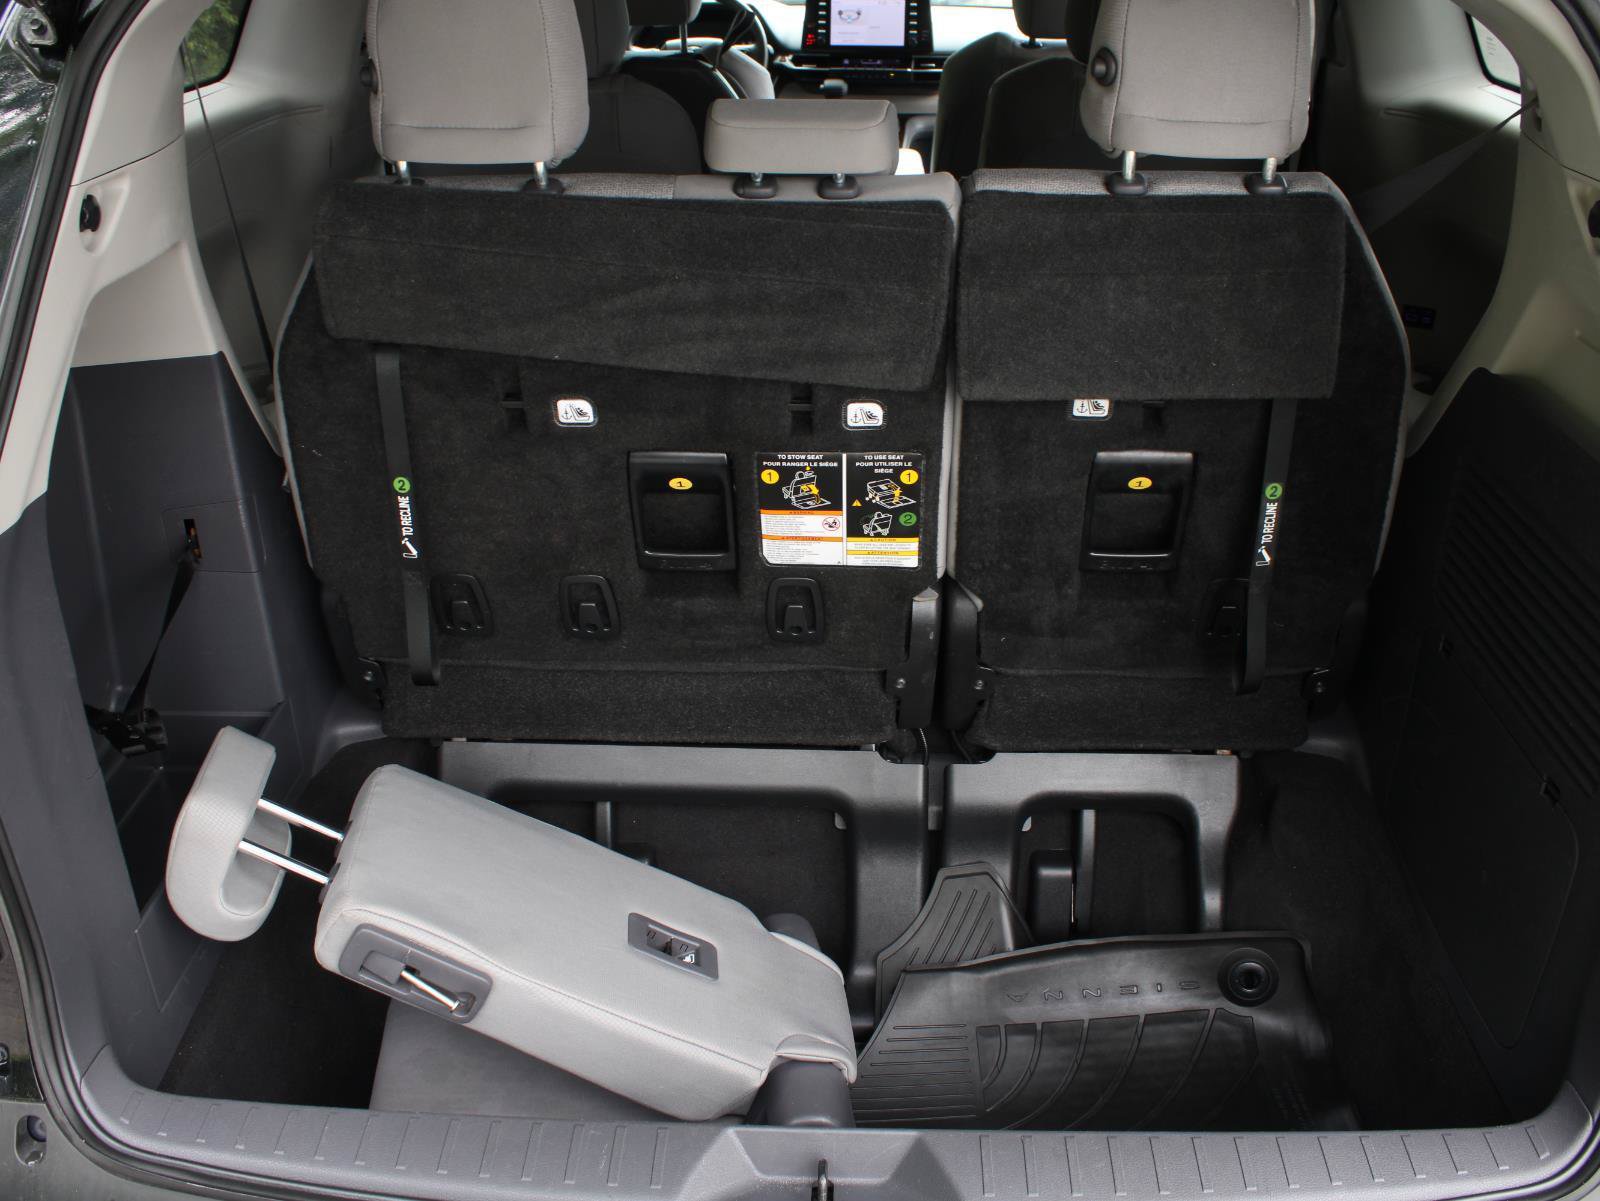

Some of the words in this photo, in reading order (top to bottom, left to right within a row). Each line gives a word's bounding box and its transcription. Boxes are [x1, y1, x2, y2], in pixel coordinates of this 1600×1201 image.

[398, 496, 412, 526] RECLINE
[1263, 503, 1278, 533] RECLINE
[402, 527, 413, 536] TO
[1261, 534, 1273, 544] TO
[1007, 981, 1201, 1002] SIENNA
